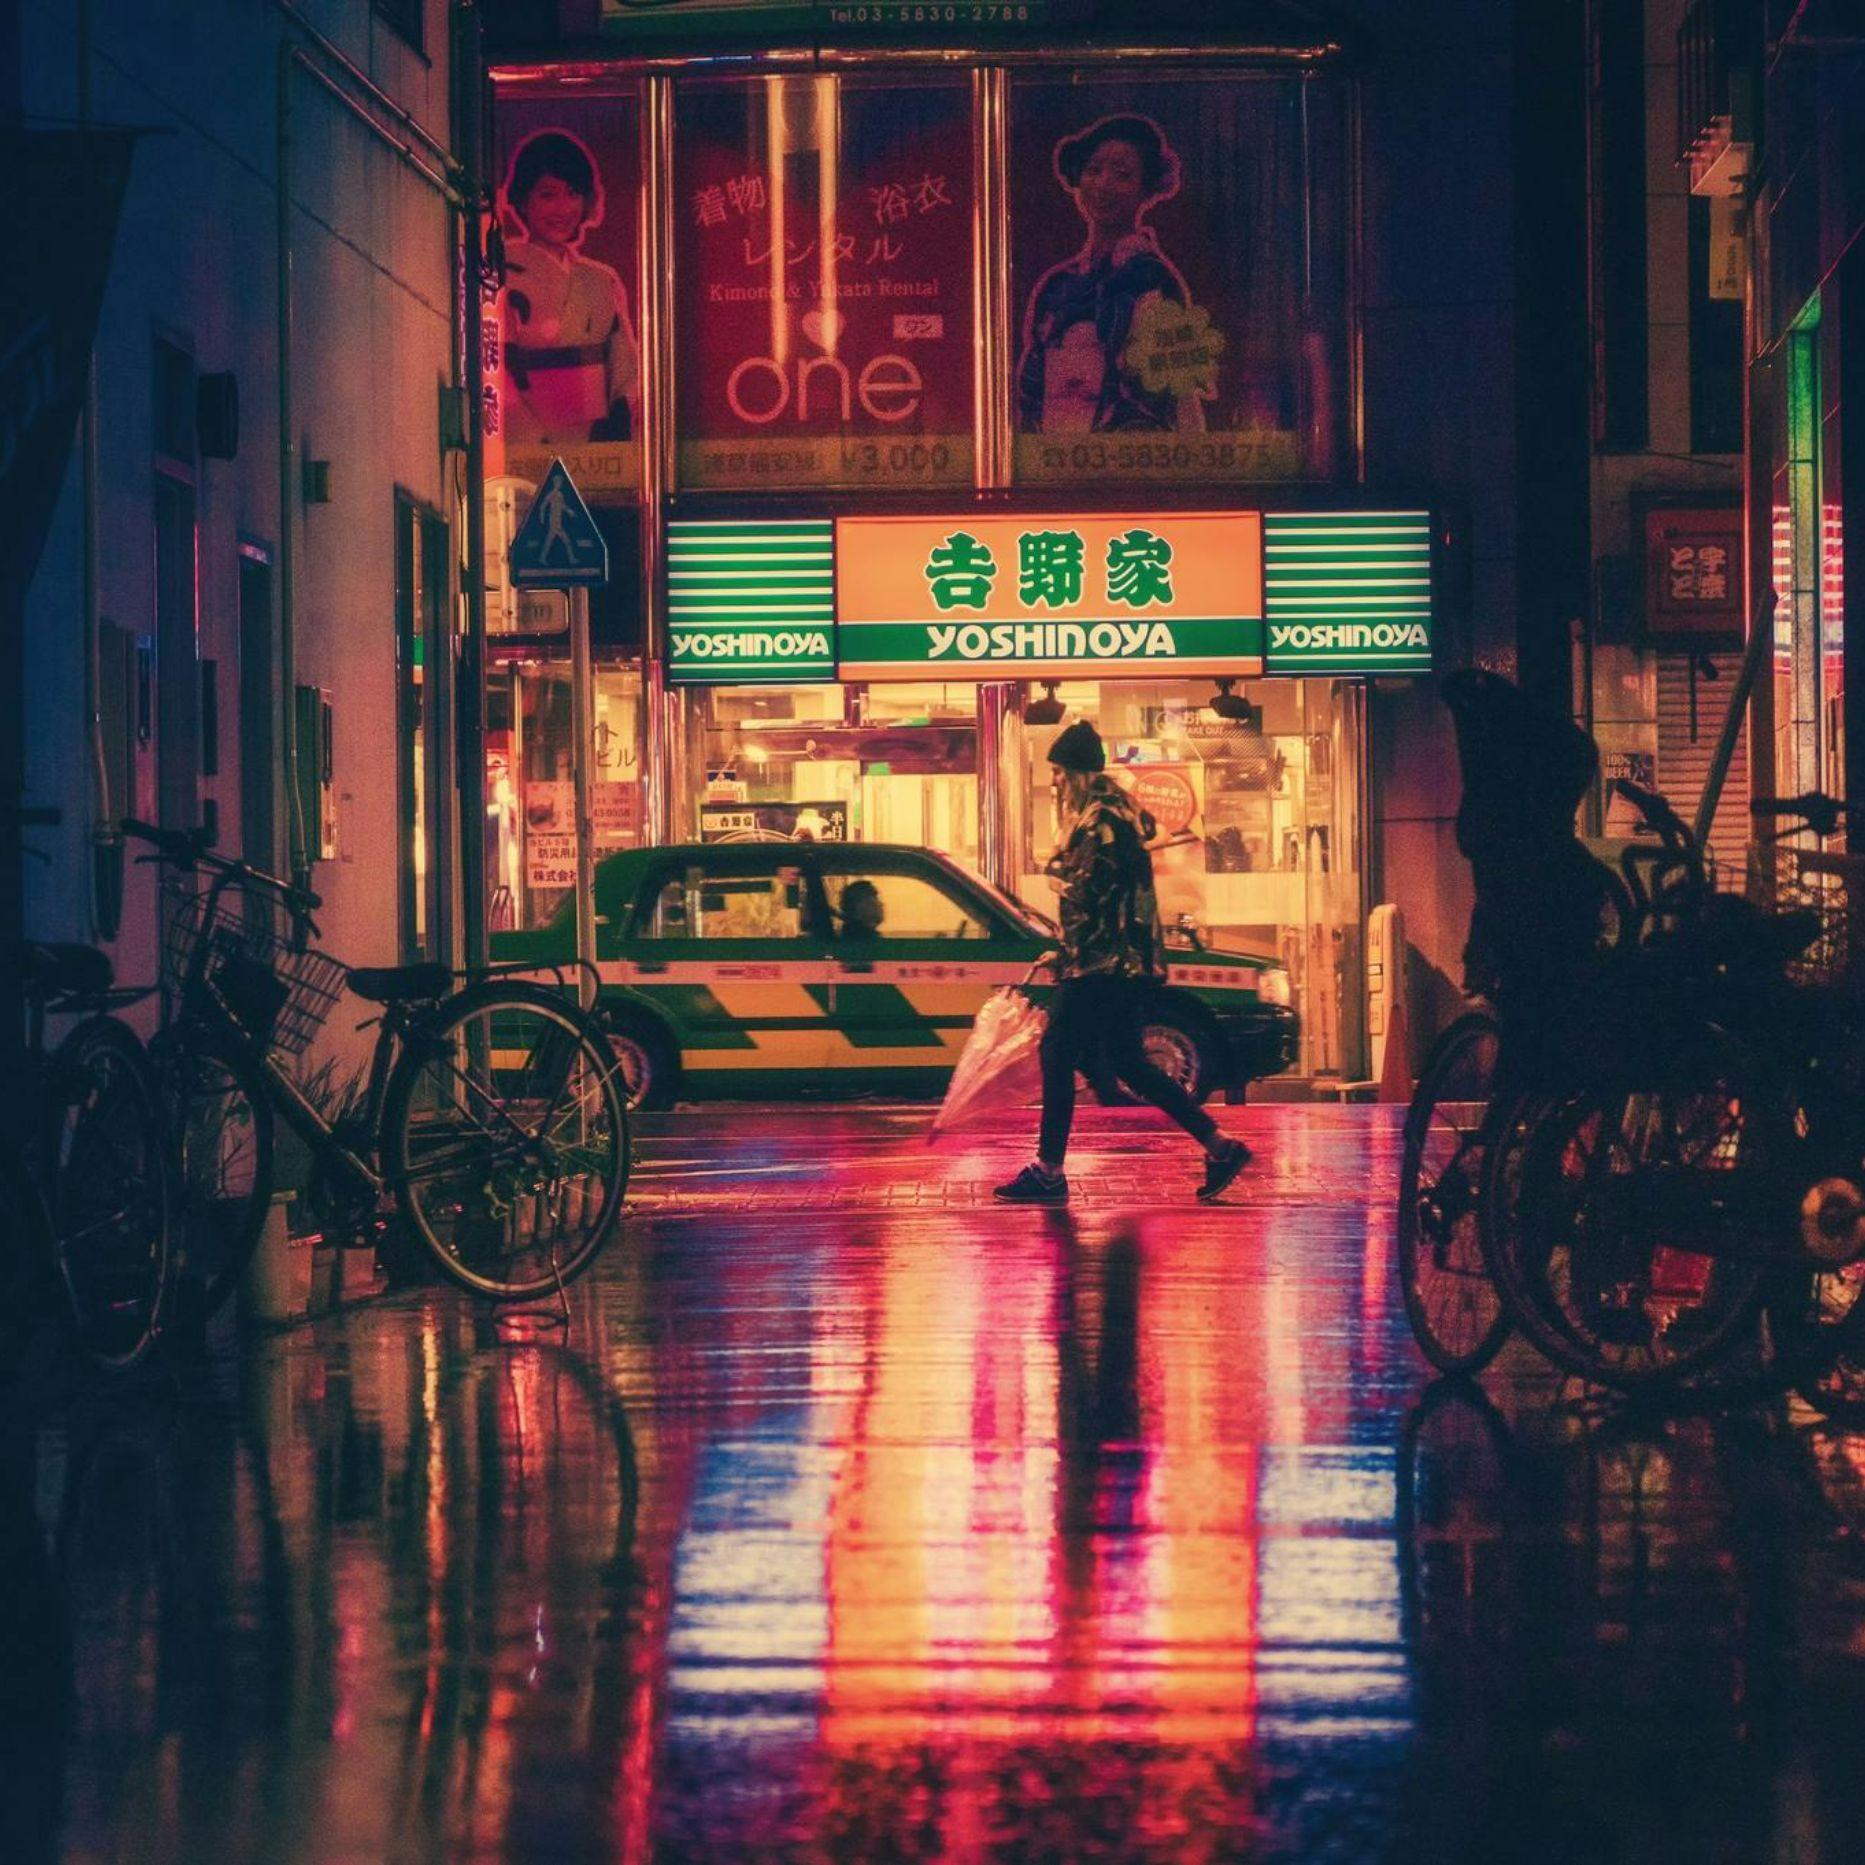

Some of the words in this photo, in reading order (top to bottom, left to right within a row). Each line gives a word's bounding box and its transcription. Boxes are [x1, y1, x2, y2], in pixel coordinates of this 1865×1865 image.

[691, 175, 764, 228] 着物
[878, 277, 939, 297] Rental
[727, 354, 922, 424] one
[924, 528, 1176, 612] 吉野家
[673, 633, 829, 657] YOSHINOYA
[926, 622, 1177, 658] YOSHINOYA
[1271, 625, 1429, 649] YOSHINOYA
